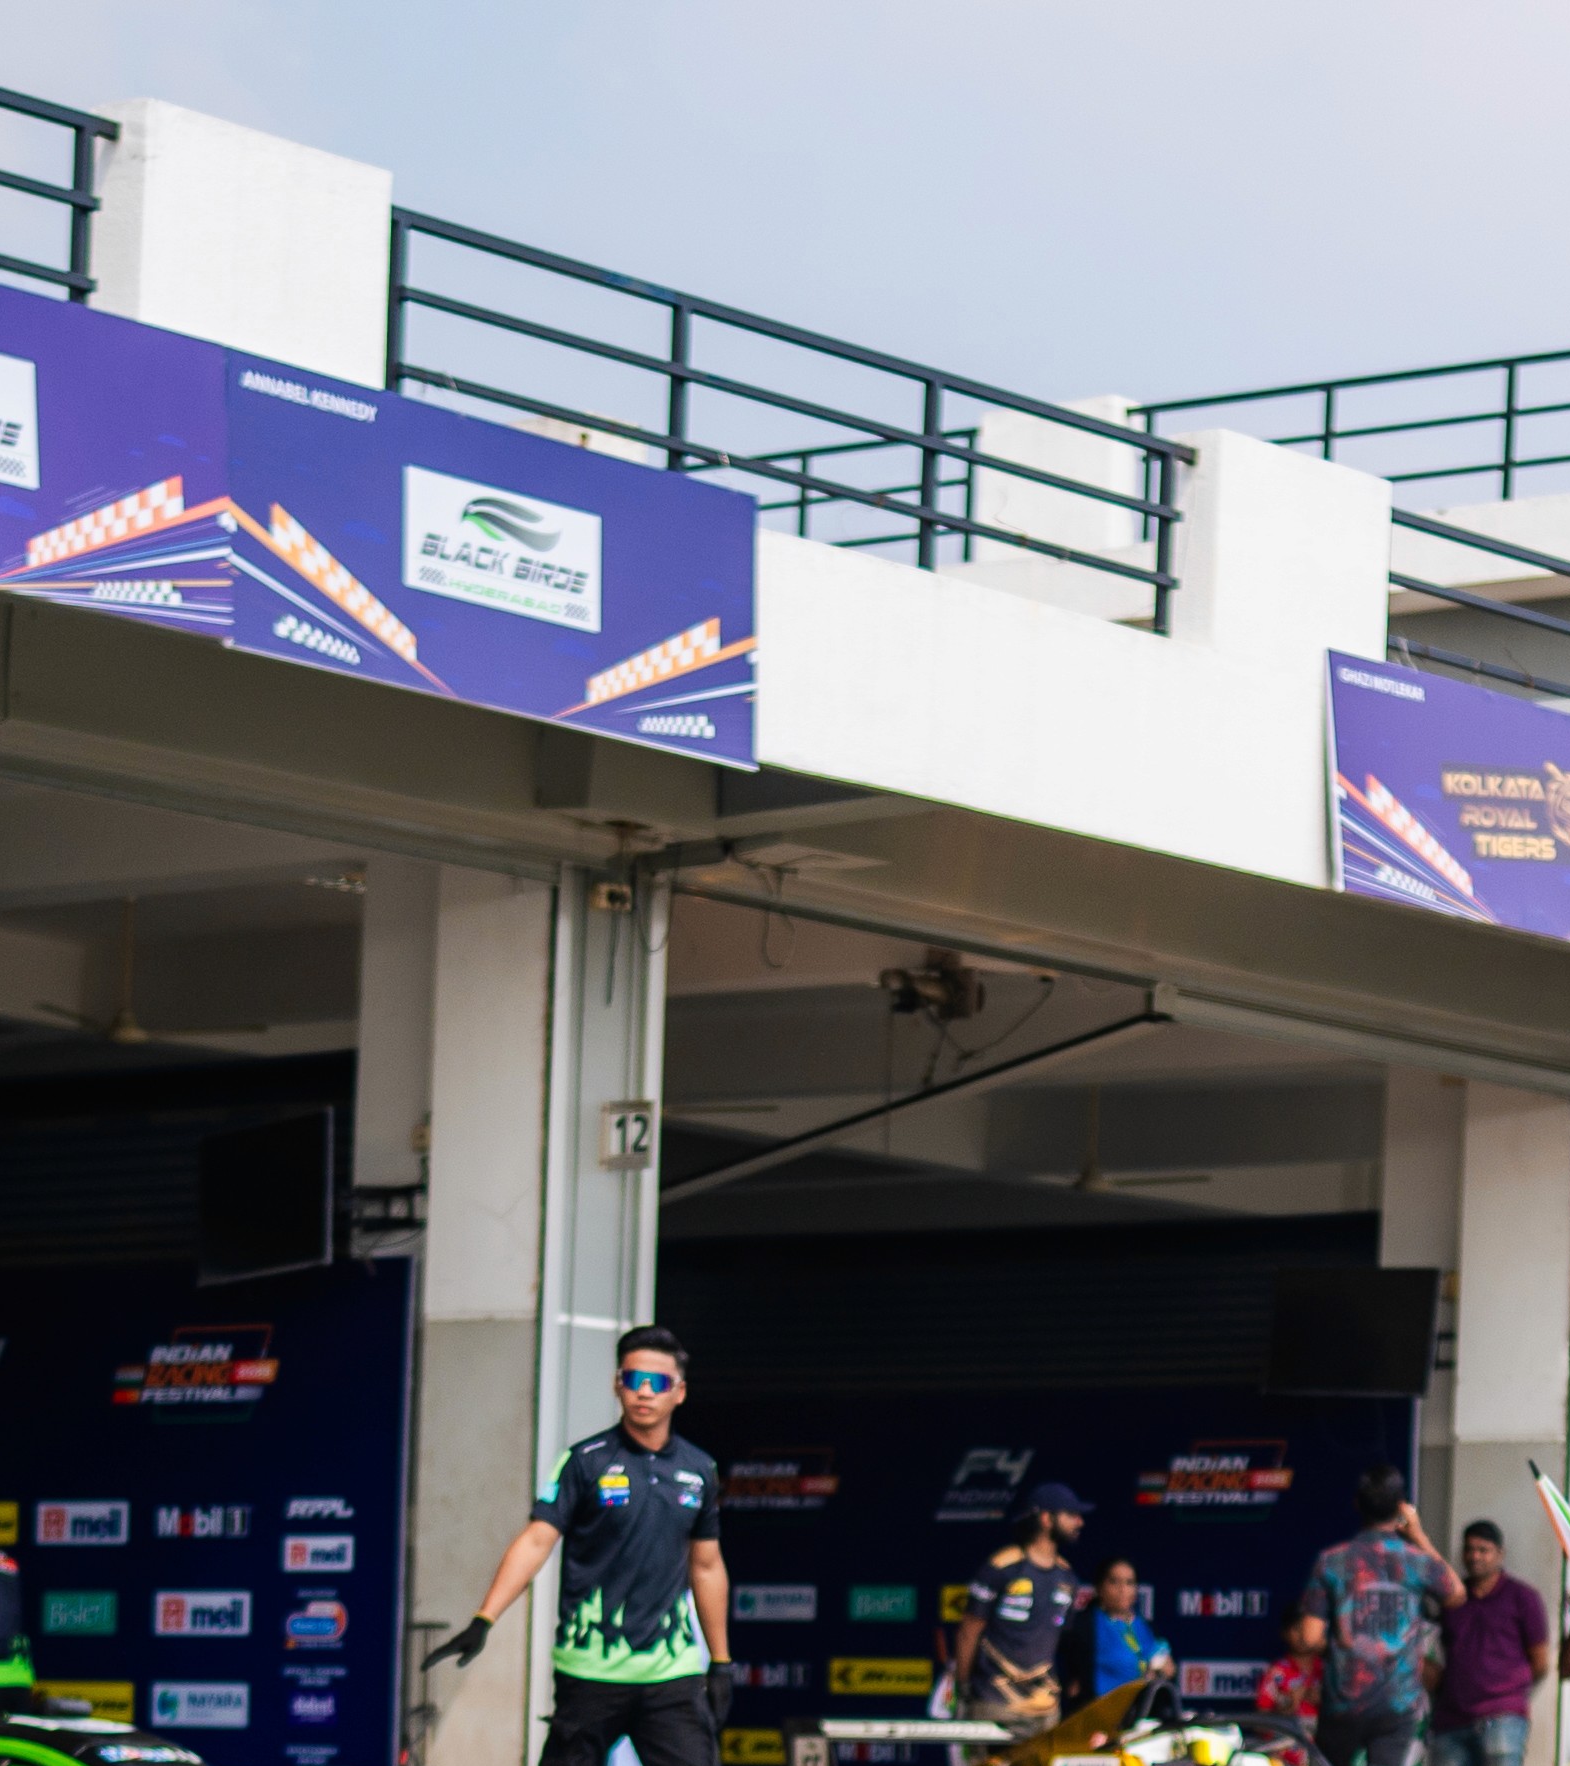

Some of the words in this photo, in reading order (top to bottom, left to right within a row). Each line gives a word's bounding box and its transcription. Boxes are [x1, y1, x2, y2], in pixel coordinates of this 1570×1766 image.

[240, 370, 310, 405] ANNABEL
[310, 389, 378, 423] KENNEDY
[420, 532, 510, 574] BLACK
[449, 578, 561, 614] HYDERABAD
[1442, 771, 1545, 801] KOLKATA
[1460, 805, 1538, 831] ROYAL
[1474, 833, 1557, 860] TIGERS
[615, 1114, 649, 1154] 12
[143, 1364, 234, 1386] RACING
[139, 1386, 239, 1403] FESTIVAL
[953, 1448, 1035, 1487] F4
[156, 1504, 223, 1538] Mobil
[1178, 1590, 1243, 1616] Mobil
